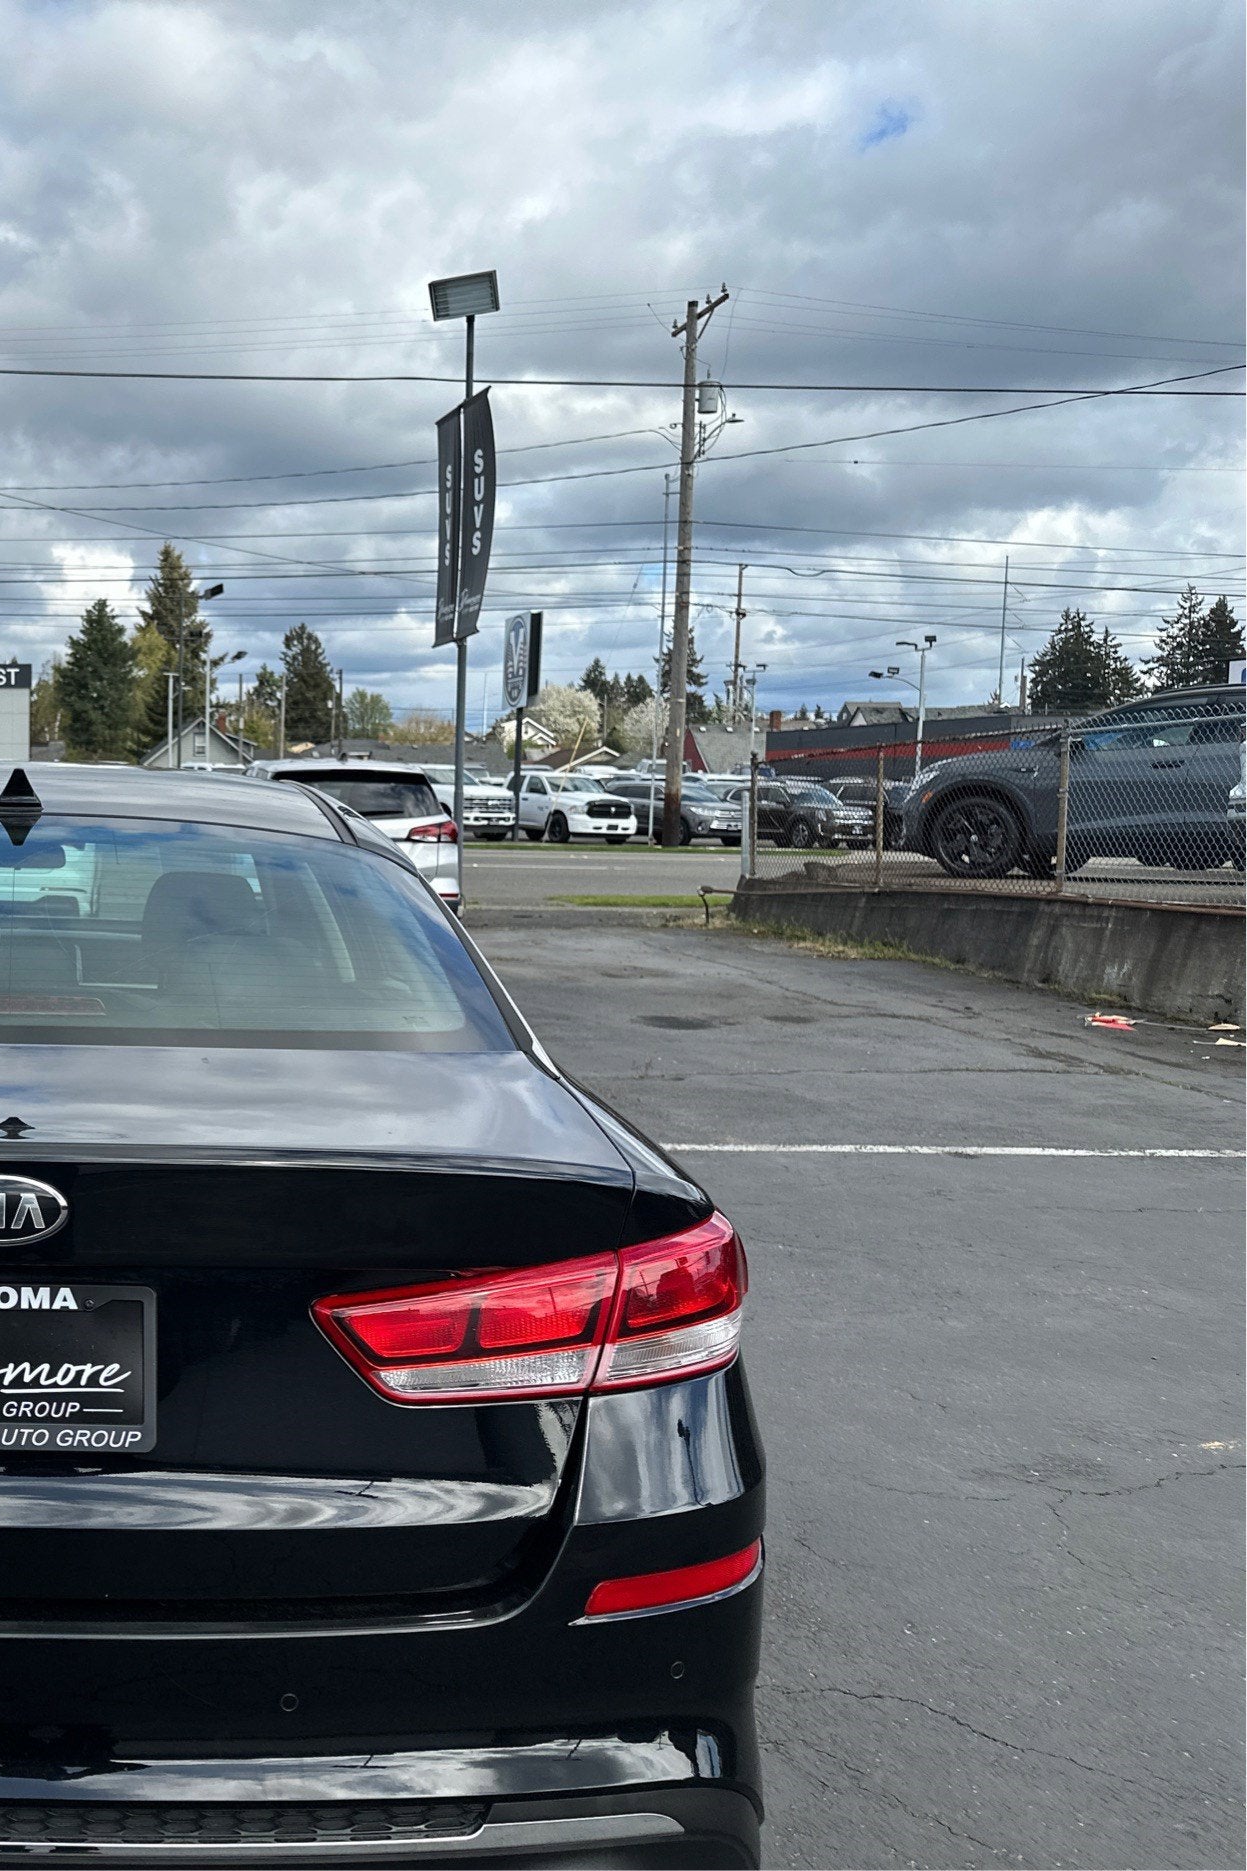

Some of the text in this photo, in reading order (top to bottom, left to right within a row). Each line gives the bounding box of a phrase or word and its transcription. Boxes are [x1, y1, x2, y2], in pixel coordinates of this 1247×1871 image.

[471, 448, 485, 556] SUVS
[2, 1402, 81, 1418] GROUP
[55, 1429, 142, 1448] GROUP
